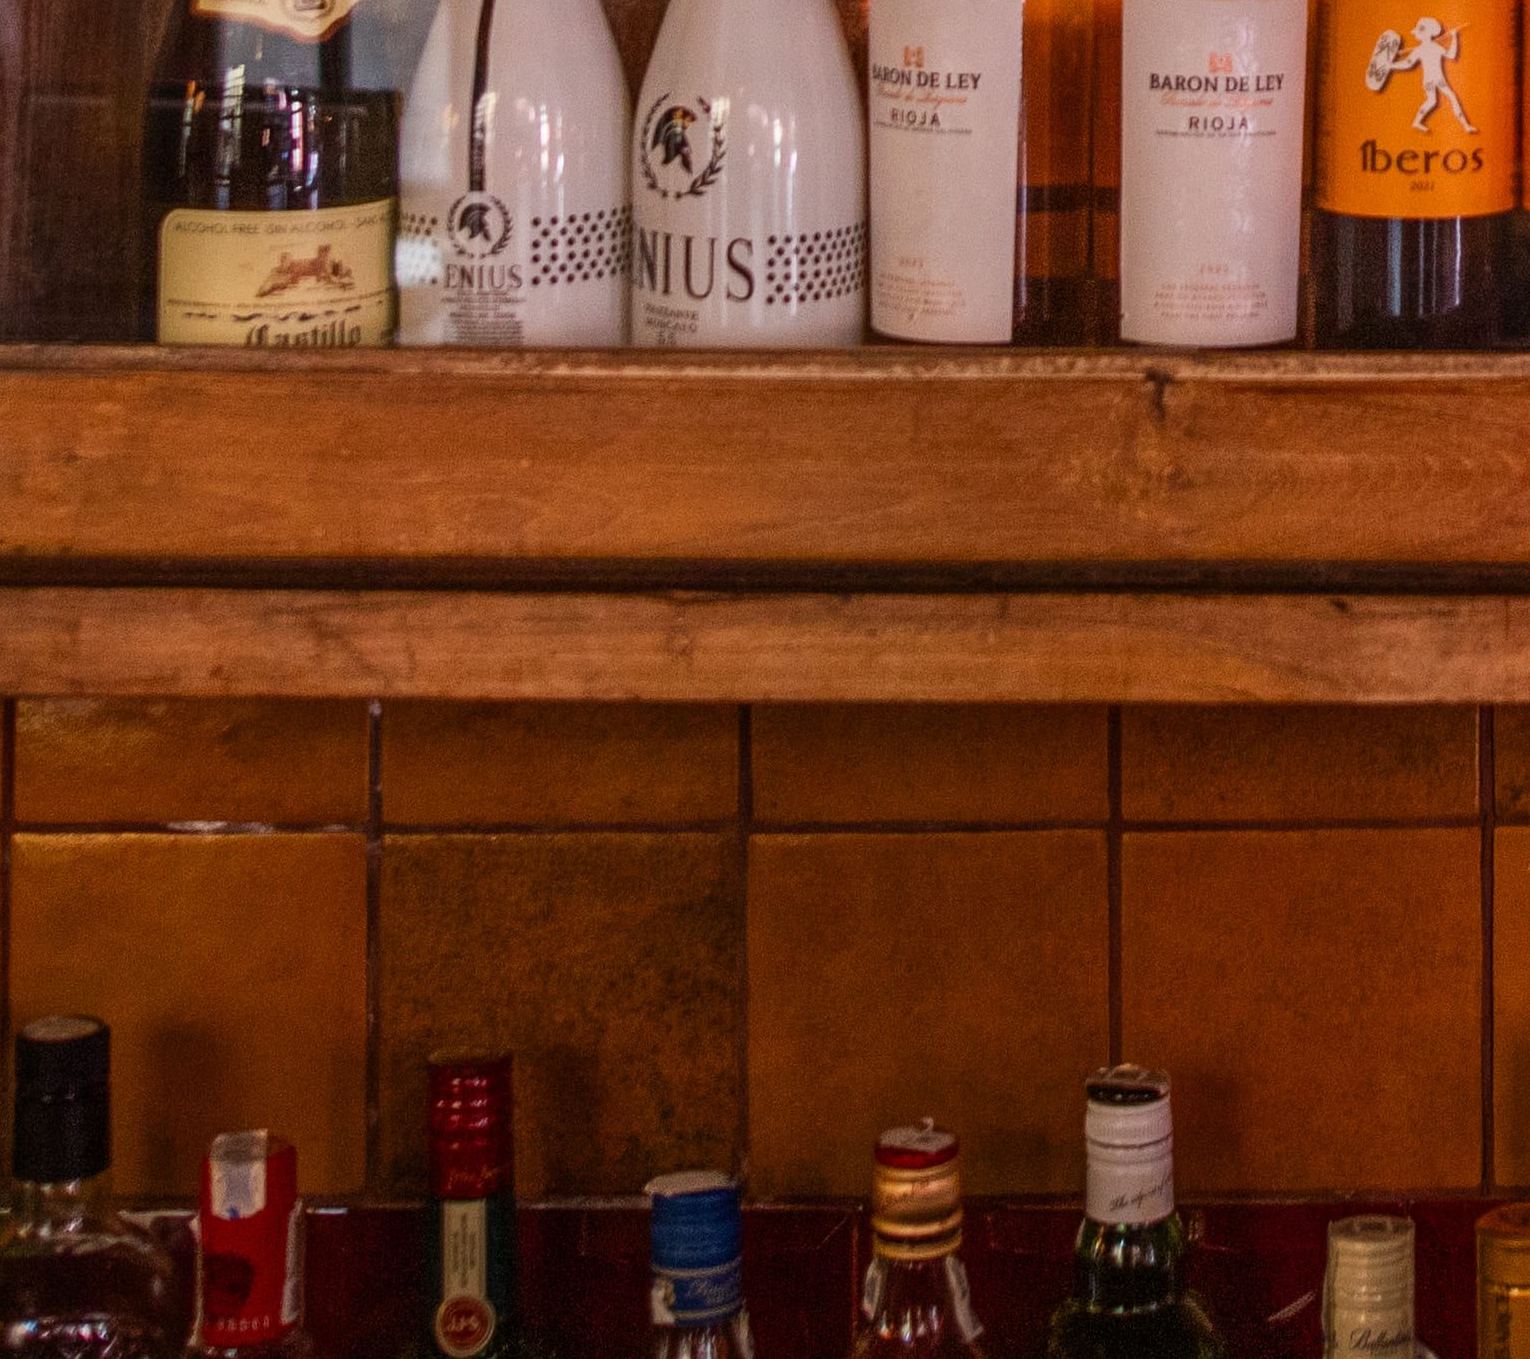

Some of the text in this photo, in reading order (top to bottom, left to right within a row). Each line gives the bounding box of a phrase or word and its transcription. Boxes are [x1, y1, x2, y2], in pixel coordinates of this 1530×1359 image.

[916, 69, 941, 89] DE
[946, 71, 982, 91] LEY
[1149, 72, 1285, 93] BARON DE LEY
[890, 107, 941, 127] RIOJA
[1188, 115, 1249, 131] RIOJA
[443, 263, 524, 289] ENIUS
